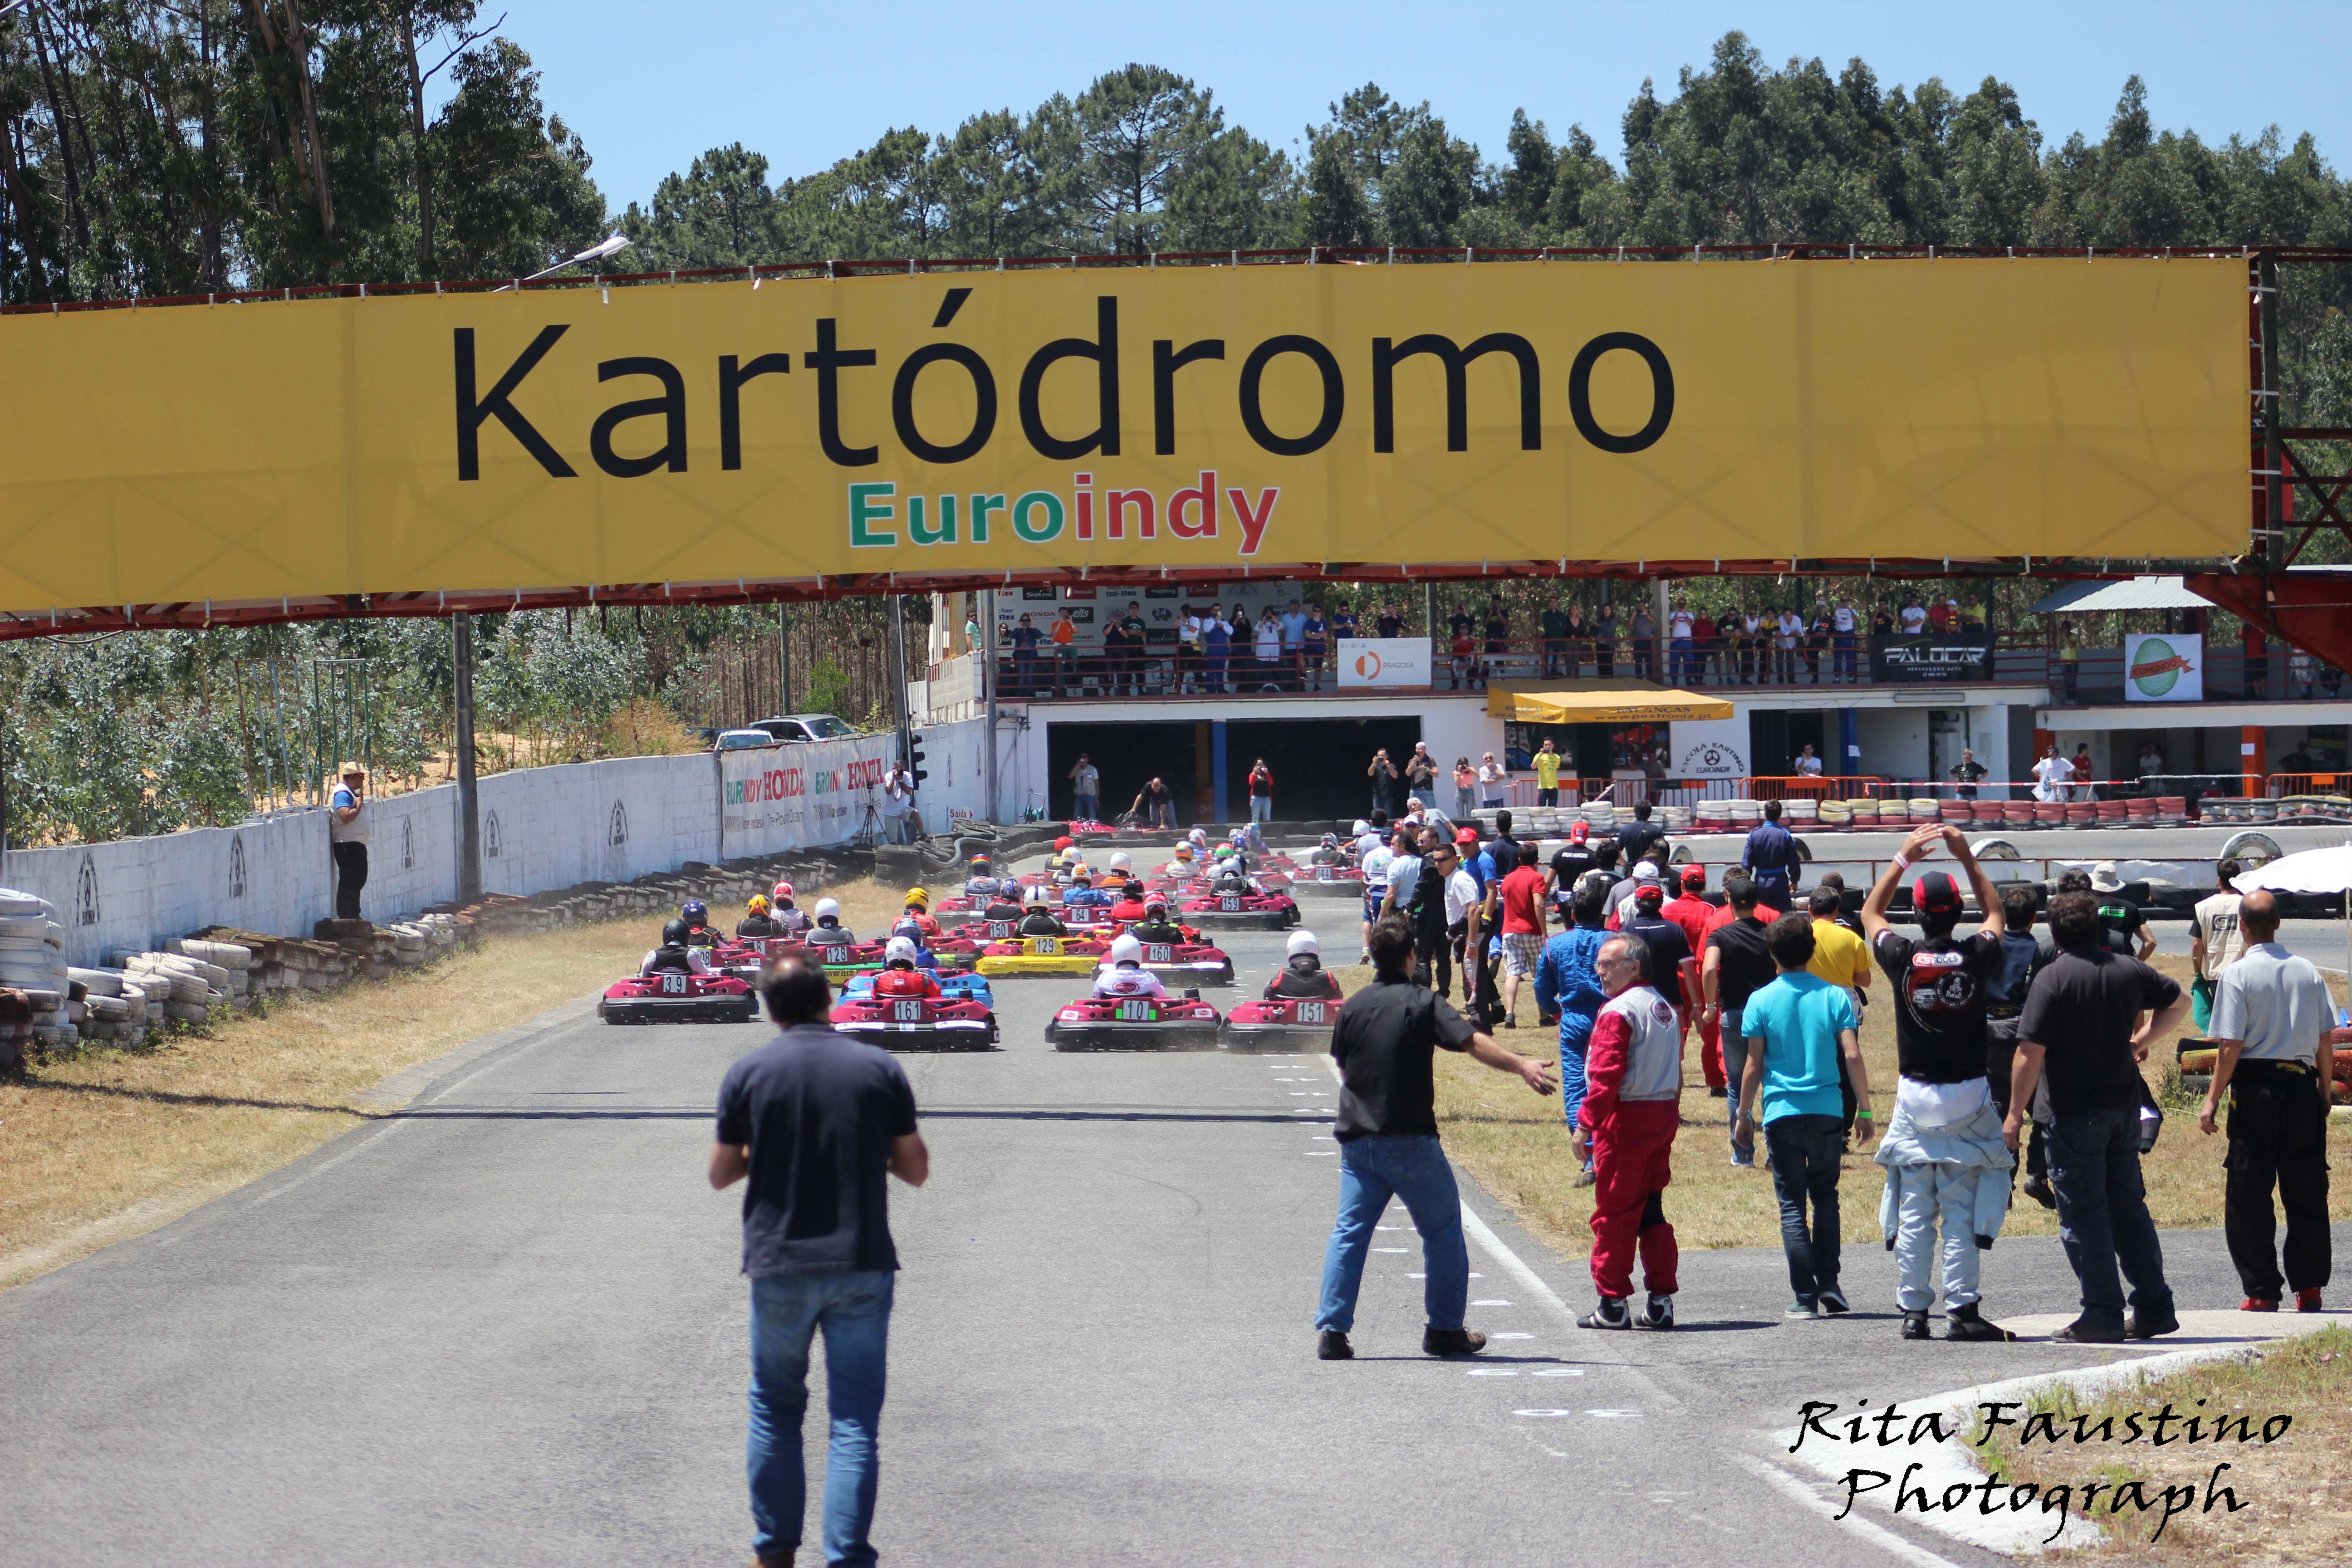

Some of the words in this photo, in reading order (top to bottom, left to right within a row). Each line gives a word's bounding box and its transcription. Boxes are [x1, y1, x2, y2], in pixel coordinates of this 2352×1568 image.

[455, 289, 1674, 481] Kartódromo
[848, 470, 1280, 555] Euroindy
[1884, 647, 1986, 663] PALOCAR
[2133, 659, 2176, 676] EDMUNDO
[1681, 744, 1706, 773] ESCOLA
[1712, 742, 1744, 772] KARTING
[950, 809, 966, 818] Saída
[978, 897, 988, 909] 52
[1222, 897, 1238, 911] 159
[1076, 909, 1085, 921] 64
[990, 924, 1005, 937] 150
[828, 946, 846, 962] 128
[1036, 939, 1054, 953] 129
[1152, 946, 1169, 960] 160
[666, 976, 682, 992] 39
[896, 1001, 920, 1020] 161
[1127, 1000, 1143, 1019] 10
[1300, 1003, 1322, 1022] 151
